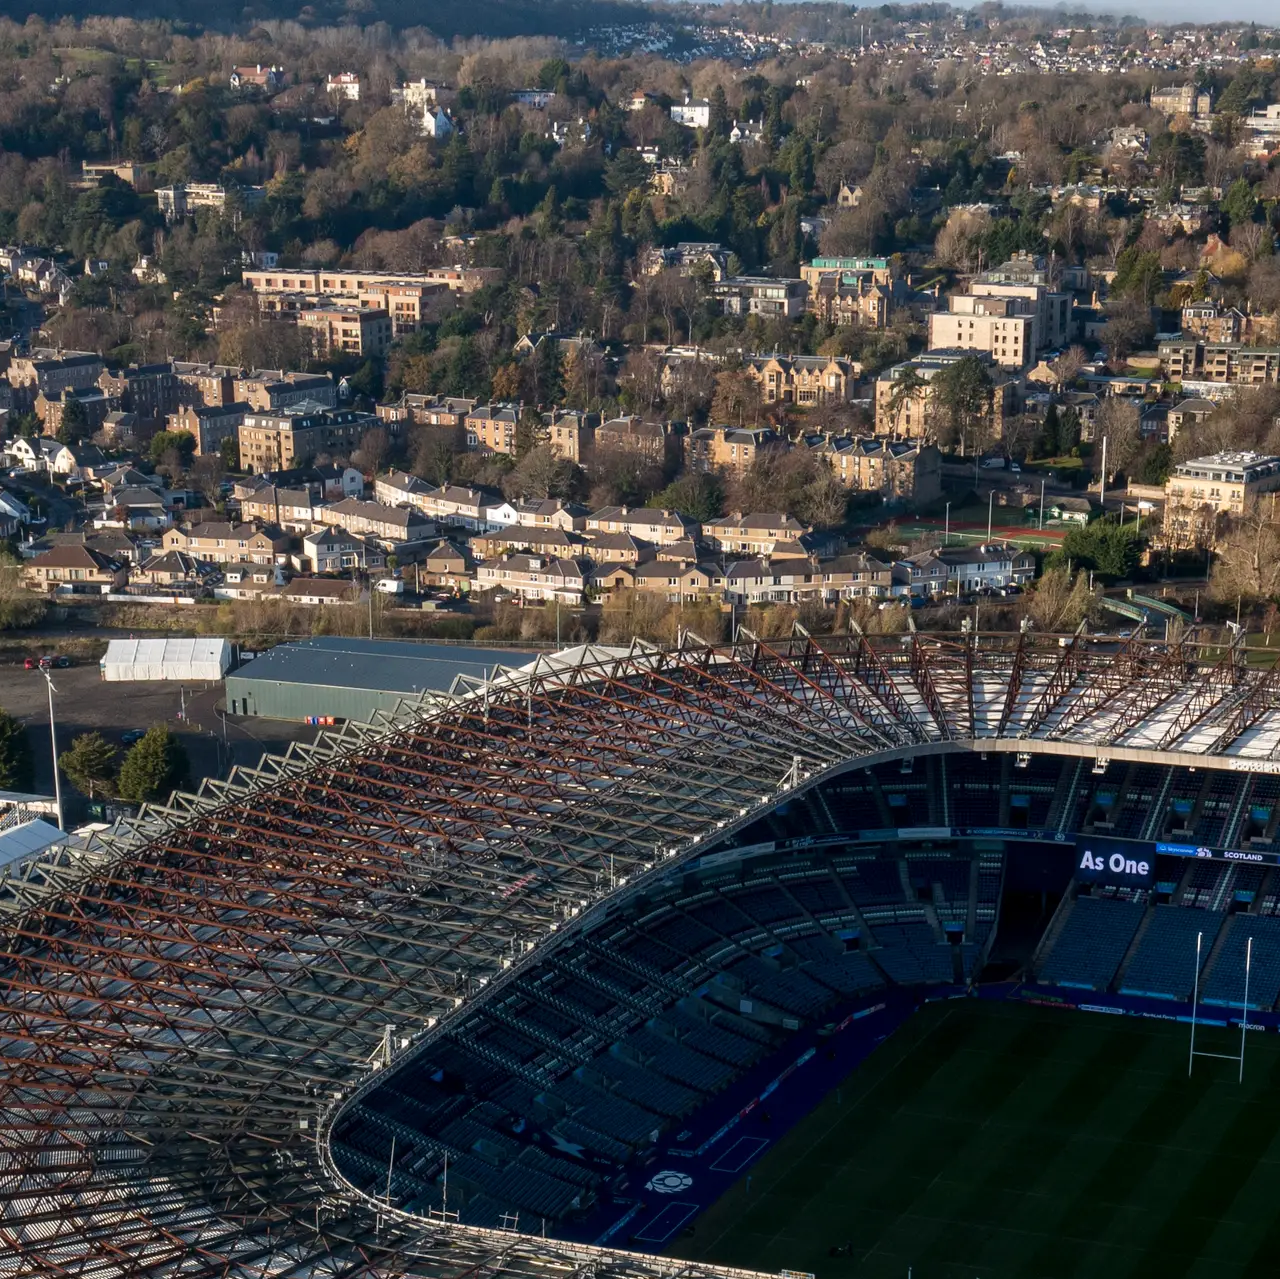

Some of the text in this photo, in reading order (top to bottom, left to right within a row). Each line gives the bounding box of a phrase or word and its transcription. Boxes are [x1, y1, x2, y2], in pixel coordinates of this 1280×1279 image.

[1080, 850, 1149, 876] As One
[1224, 851, 1263, 861] SCOTLAND
